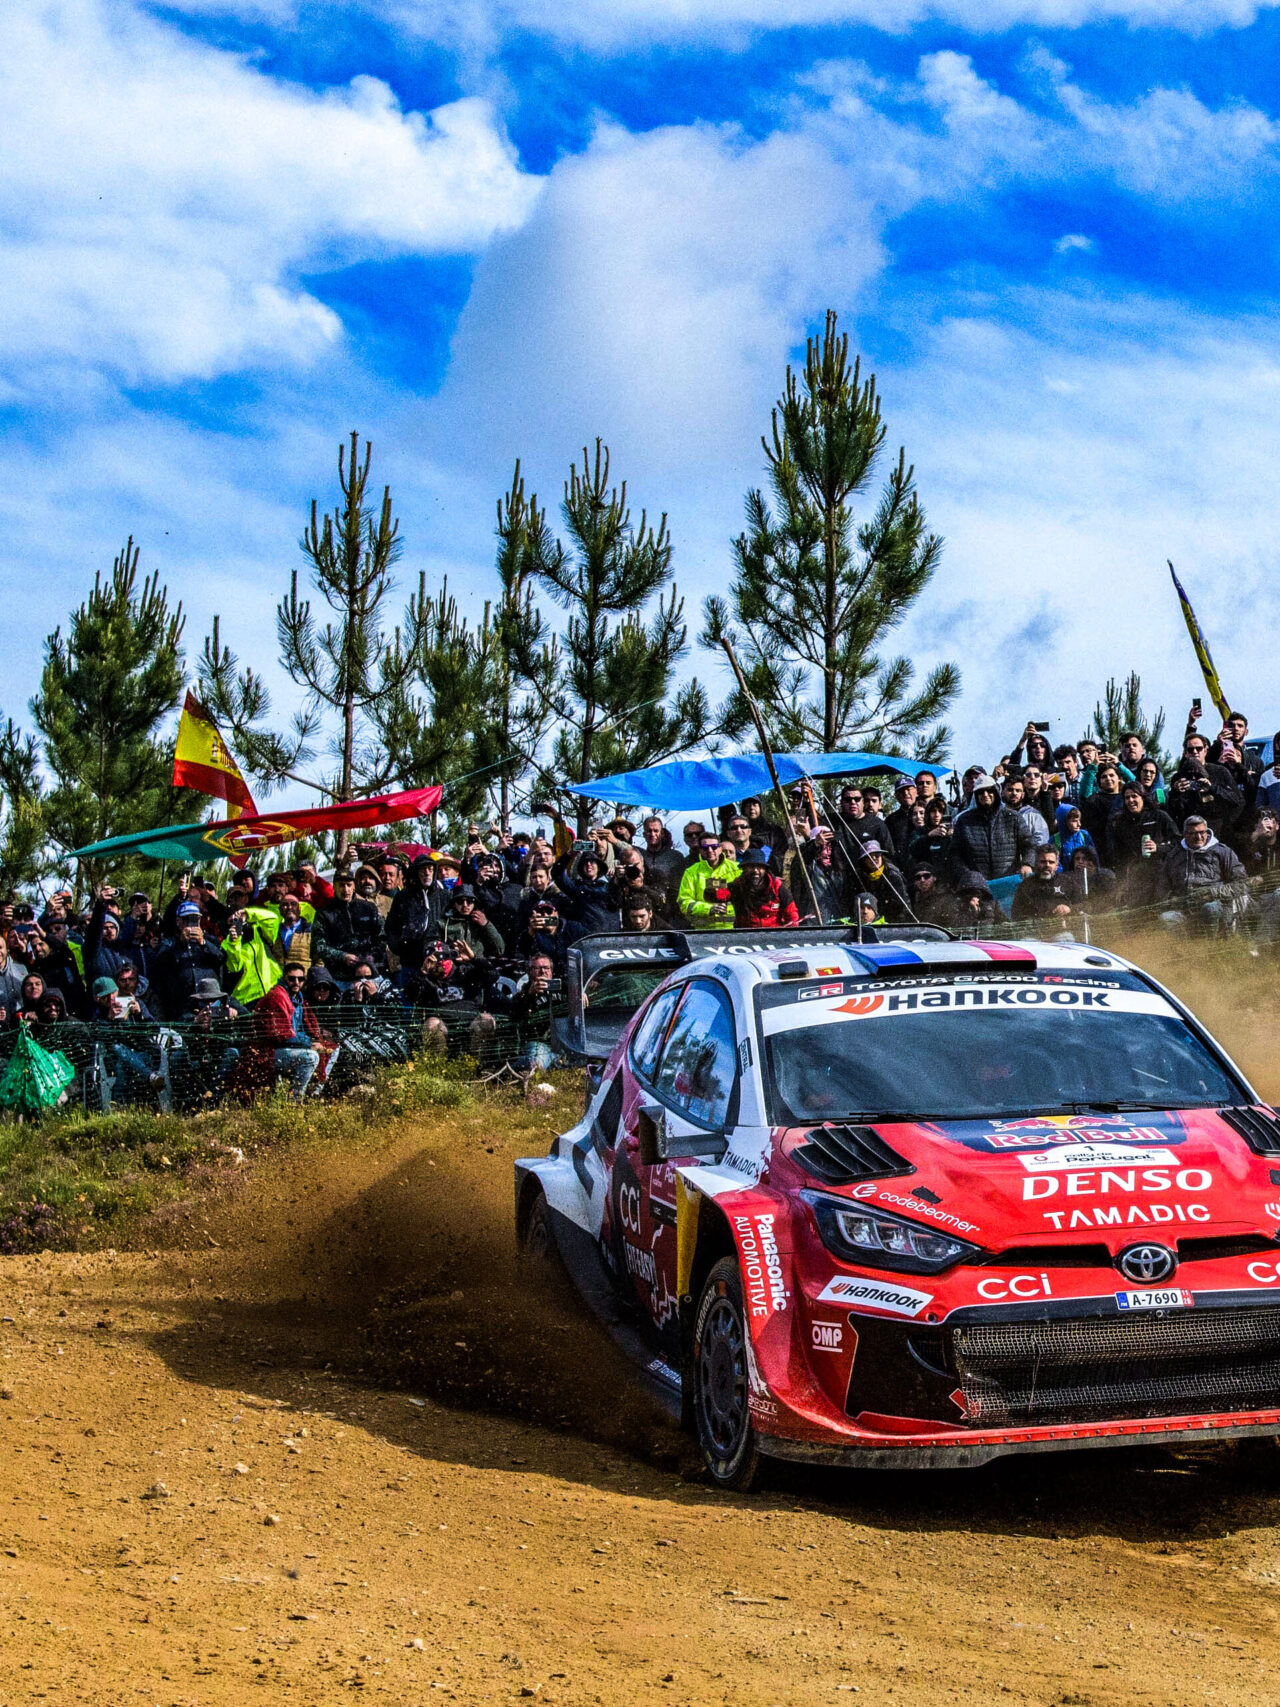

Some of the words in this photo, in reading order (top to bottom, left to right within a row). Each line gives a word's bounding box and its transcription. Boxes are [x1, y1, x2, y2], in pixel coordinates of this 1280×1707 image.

[599, 948, 680, 960] GIVE
[799, 985, 843, 1000] GR
[851, 975, 948, 991] TOYOTA
[953, 974, 1038, 986] GAZOO
[1043, 975, 1120, 989] Racing
[984, 1130, 1079, 1148] Red
[1076, 1127, 1168, 1143] Bull
[724, 1151, 756, 1176] TAMADIC
[1022, 1168, 1213, 1201] DENSO
[879, 1190, 979, 1234] codebeamer
[1043, 1204, 1211, 1230] TAMADIC
[733, 1215, 769, 1318] AUTOMOTIVE
[754, 1213, 790, 1312] Panasonic
[1132, 1292, 1179, 1306] A-7690
[812, 1325, 843, 1348] OMP
